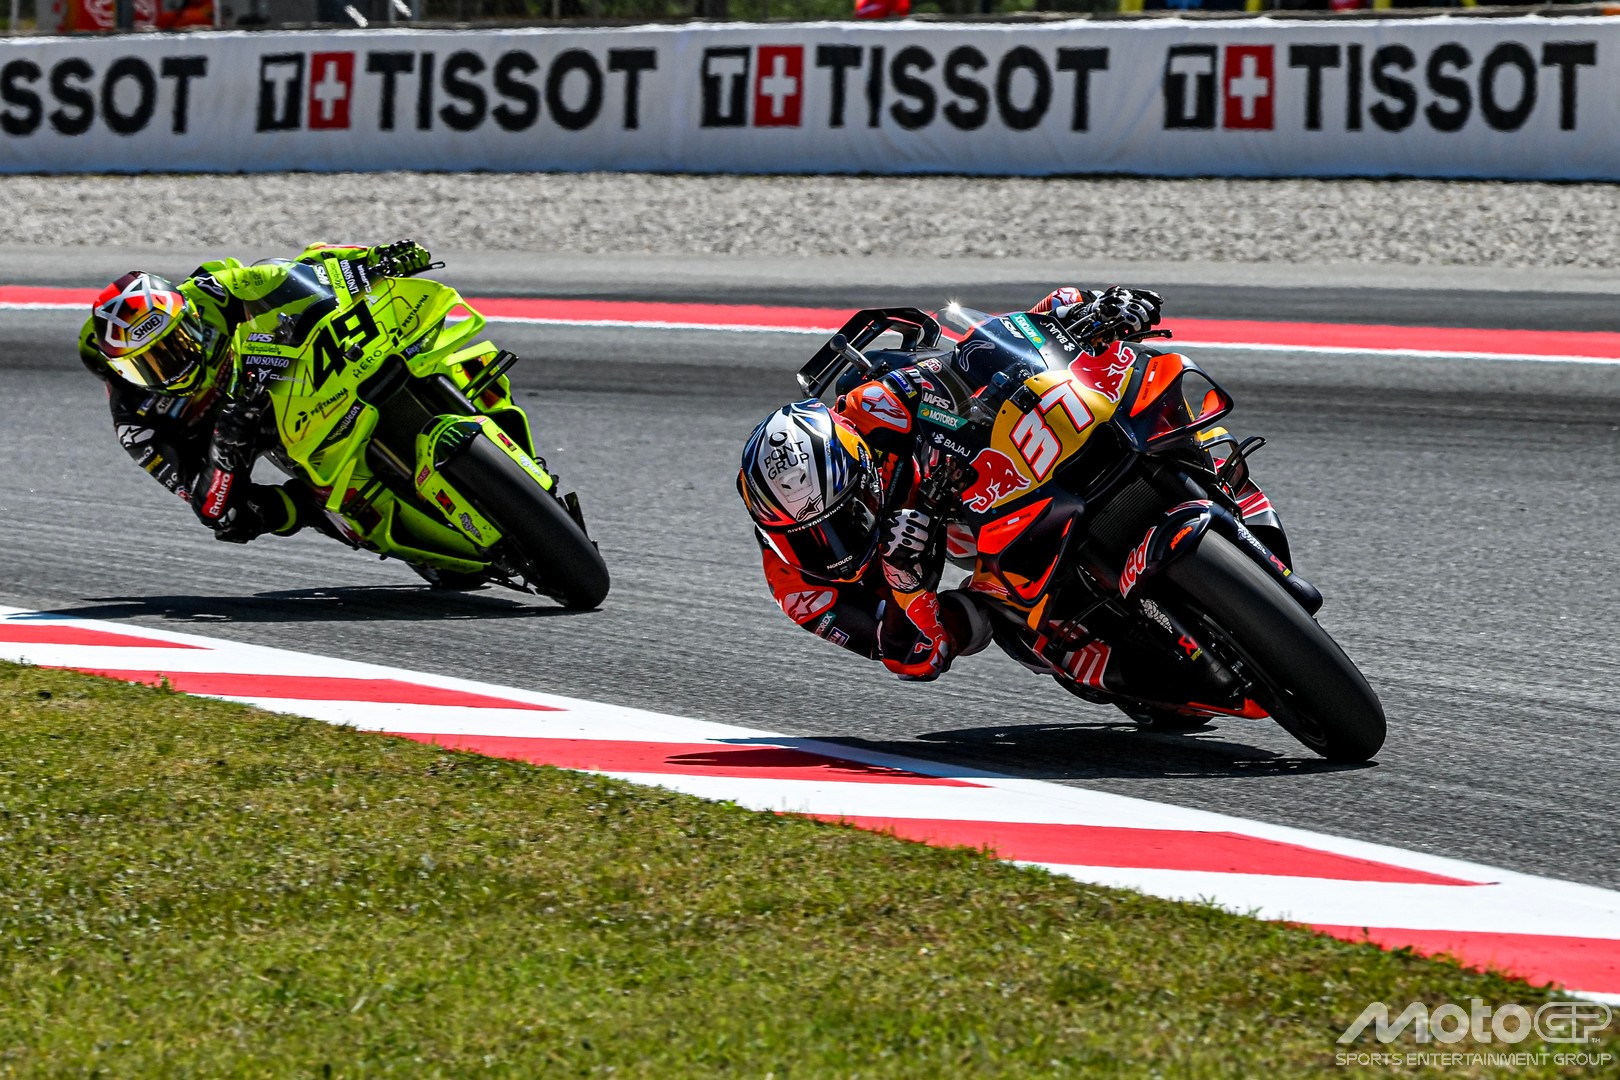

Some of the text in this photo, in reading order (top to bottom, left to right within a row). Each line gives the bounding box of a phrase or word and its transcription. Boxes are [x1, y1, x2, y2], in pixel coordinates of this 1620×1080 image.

[365, 47, 658, 132] TISSOT
[814, 43, 1110, 132] TISSOT
[1288, 41, 1598, 133] TISSOT
[340, 259, 359, 295] LINO SONEGO
[357, 264, 372, 293] CUPRA
[401, 294, 429, 328] PERTAMINA
[134, 316, 161, 339] SHOEI
[248, 333, 275, 342] WRS
[1014, 314, 1039, 339] MOTOREX
[1045, 322, 1069, 344] BAJAJ
[312, 299, 380, 392] 49
[245, 355, 290, 368] LINO SONEGO
[353, 349, 383, 379] HERO
[310, 388, 349, 415] PERTAMINA
[923, 392, 951, 410] WRS
[929, 410, 959, 428] MOTOREX
[1009, 380, 1095, 483] 37
[763, 441, 805, 469] PONT
[943, 439, 971, 457] BAJAJ
[768, 452, 809, 480] GRUP
[209, 473, 231, 516] Enduro
[1170, 526, 1193, 550] KTM
[826, 555, 853, 570] Norauto
